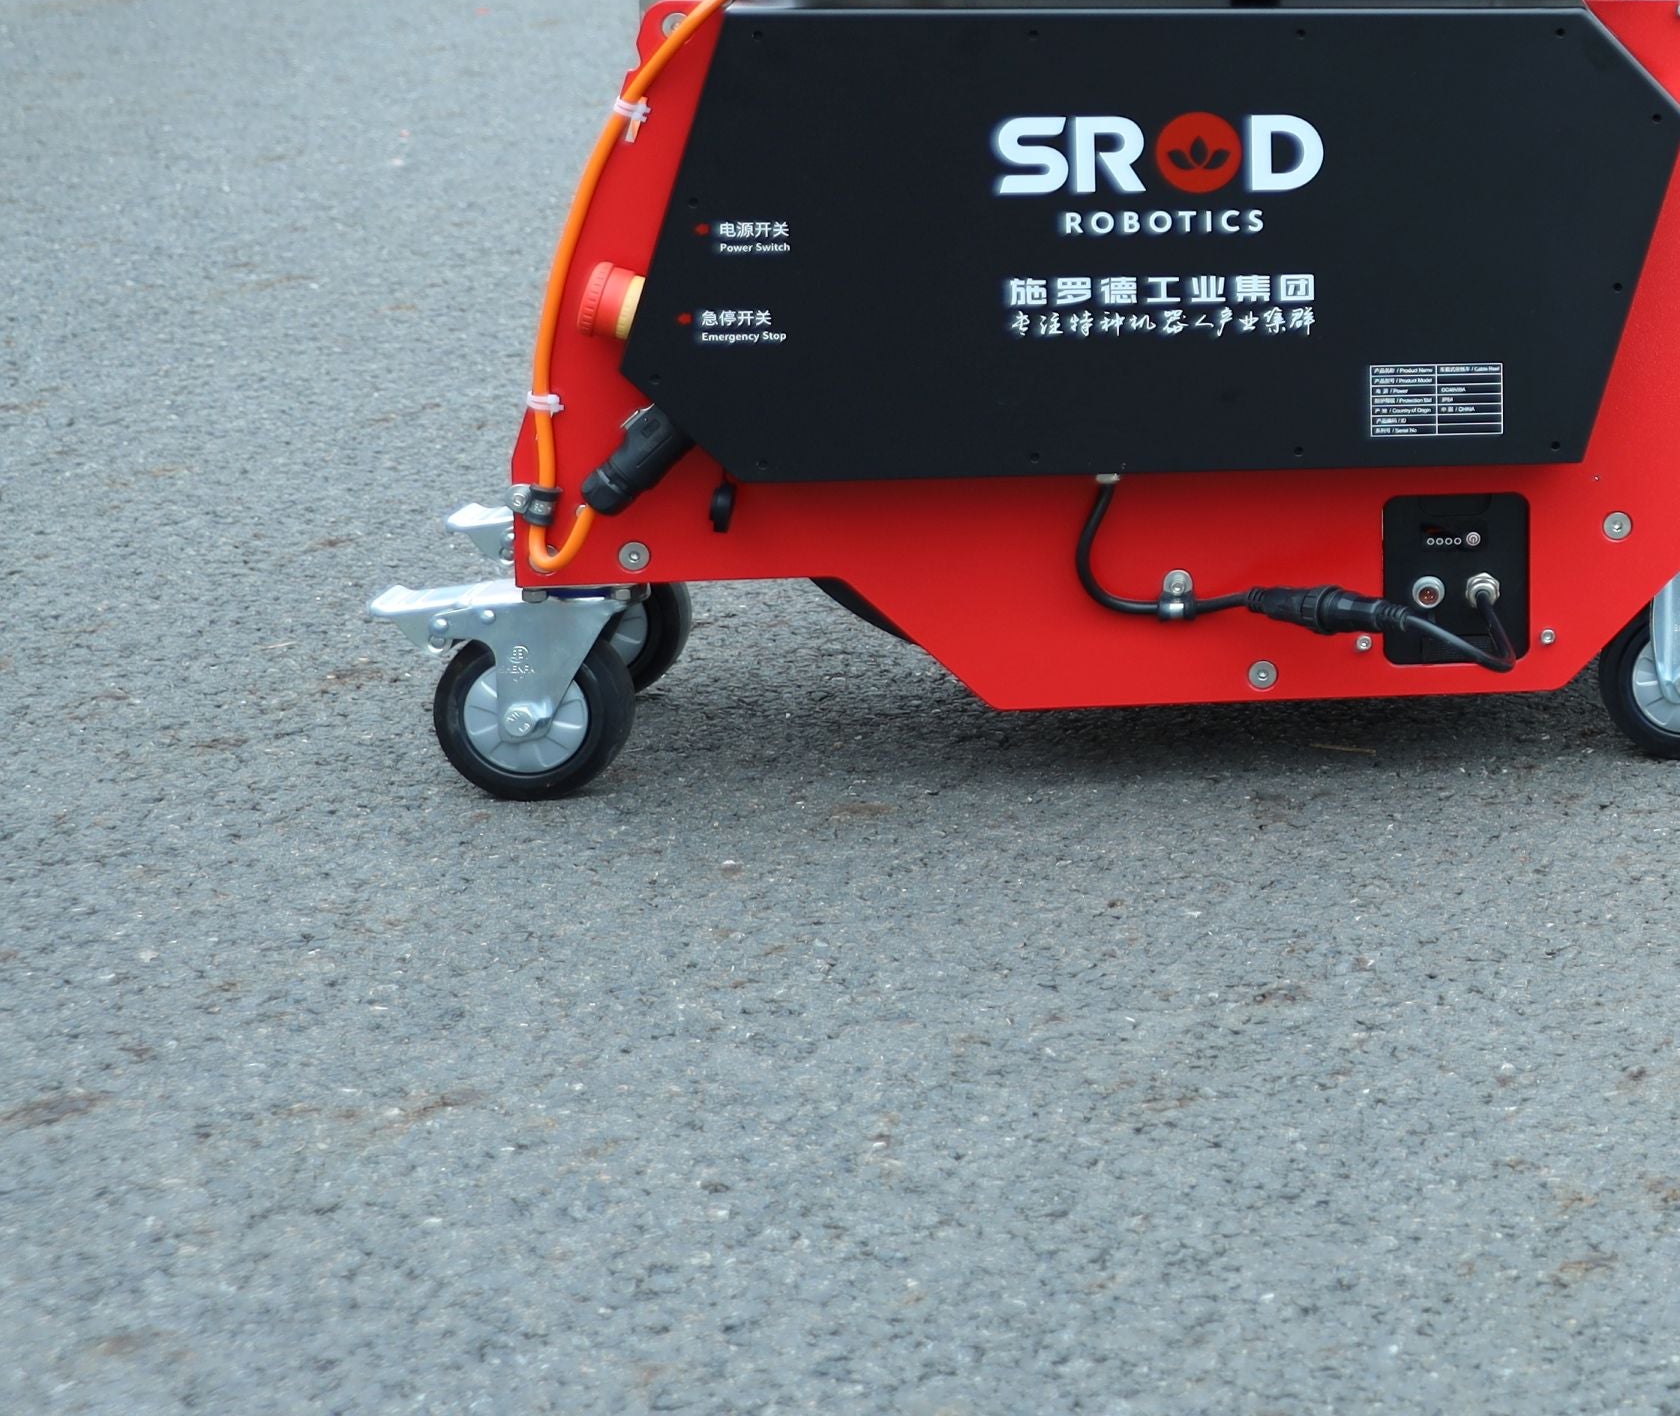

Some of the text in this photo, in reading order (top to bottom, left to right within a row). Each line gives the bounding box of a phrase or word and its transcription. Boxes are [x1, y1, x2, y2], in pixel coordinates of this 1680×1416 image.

[997, 112, 1323, 195] SROD
[719, 221, 790, 238] 电源开关
[1064, 210, 1264, 234] ROBOTICS
[720, 242, 790, 252] Power Switch
[1009, 274, 1315, 305] 施罗德工业集团
[701, 309, 772, 326] 急停开关
[1011, 306, 1316, 336] 专注特种机器人产业集群
[702, 330, 787, 343] Emergency Stop
